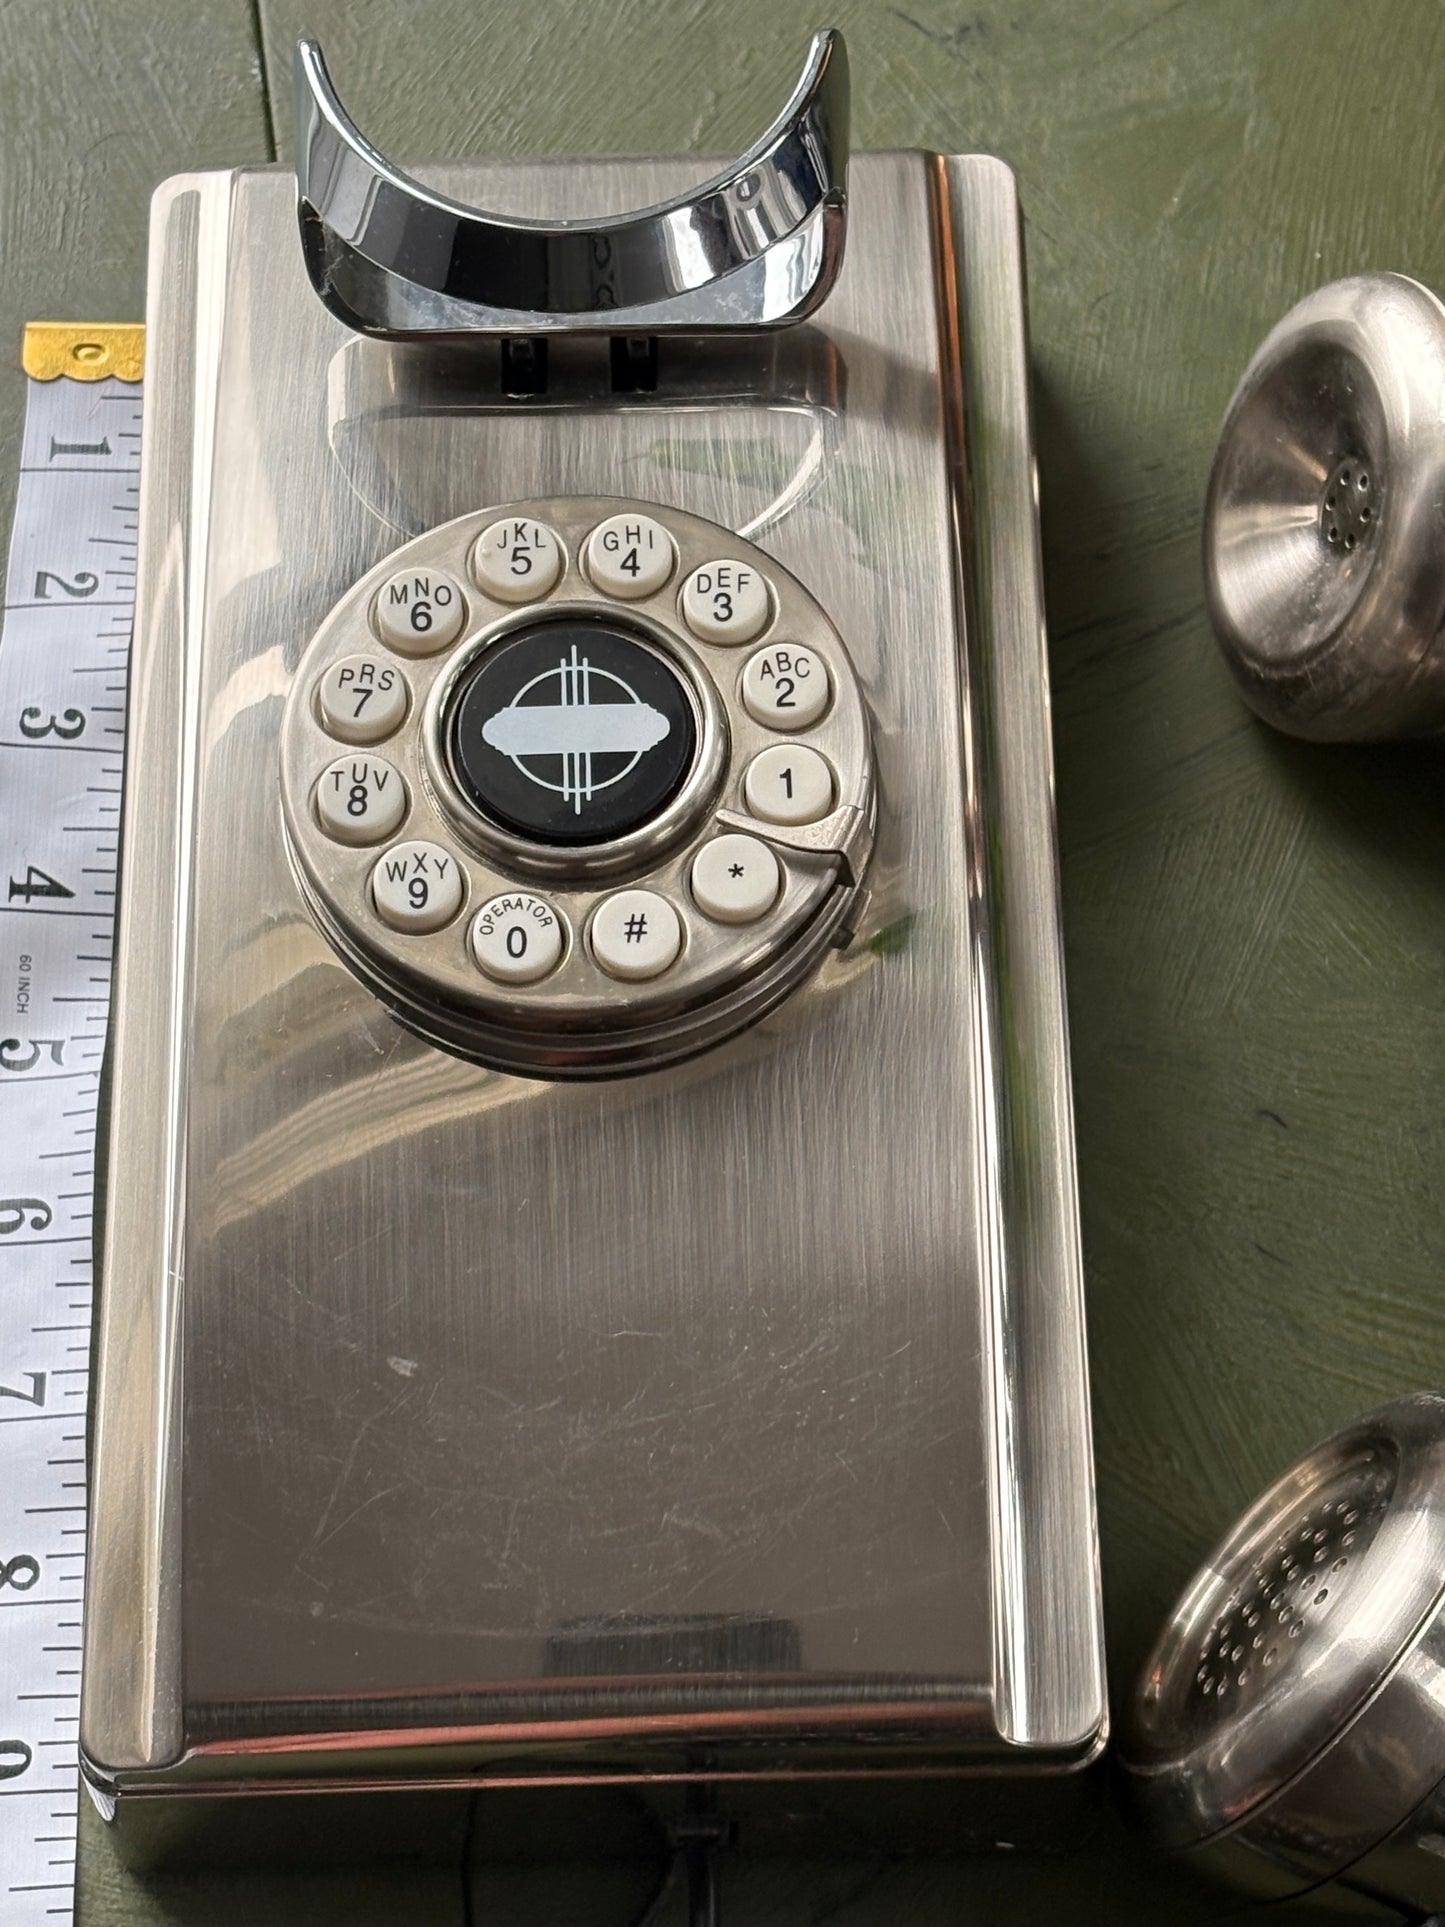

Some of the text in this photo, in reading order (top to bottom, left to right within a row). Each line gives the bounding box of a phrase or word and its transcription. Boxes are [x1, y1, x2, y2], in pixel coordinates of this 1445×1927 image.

[49, 436, 112, 461] 1
[497, 522, 547, 550] JKL
[603, 525, 654, 551] GHI
[510, 546, 532, 576] 5
[619, 548, 641, 577] 4
[34, 571, 99, 599] 2
[389, 579, 453, 606] MNO
[695, 568, 752, 594] DEF
[410, 601, 433, 633] 6
[713, 592, 733, 623] 3
[339, 663, 395, 691] PRS
[759, 651, 811, 680] ABC
[352, 687, 372, 718] 7
[775, 677, 796, 708] 2
[19, 706, 86, 739] 3
[330, 763, 390, 791] TUV
[779, 767, 793, 799] 1
[347, 784, 368, 817] 8
[386, 854, 450, 882] WXY
[9, 866, 76, 903] 4
[408, 877, 429, 910] 9
[479, 896, 553, 936] OPERATOR
[623, 913, 648, 943] #
[506, 925, 528, 959] 0
[17, 954, 32, 1014] 60 INCH
[0, 1038, 65, 1072] 5
[0, 1198, 52, 1235] 6
[0, 1372, 47, 1408] 7
